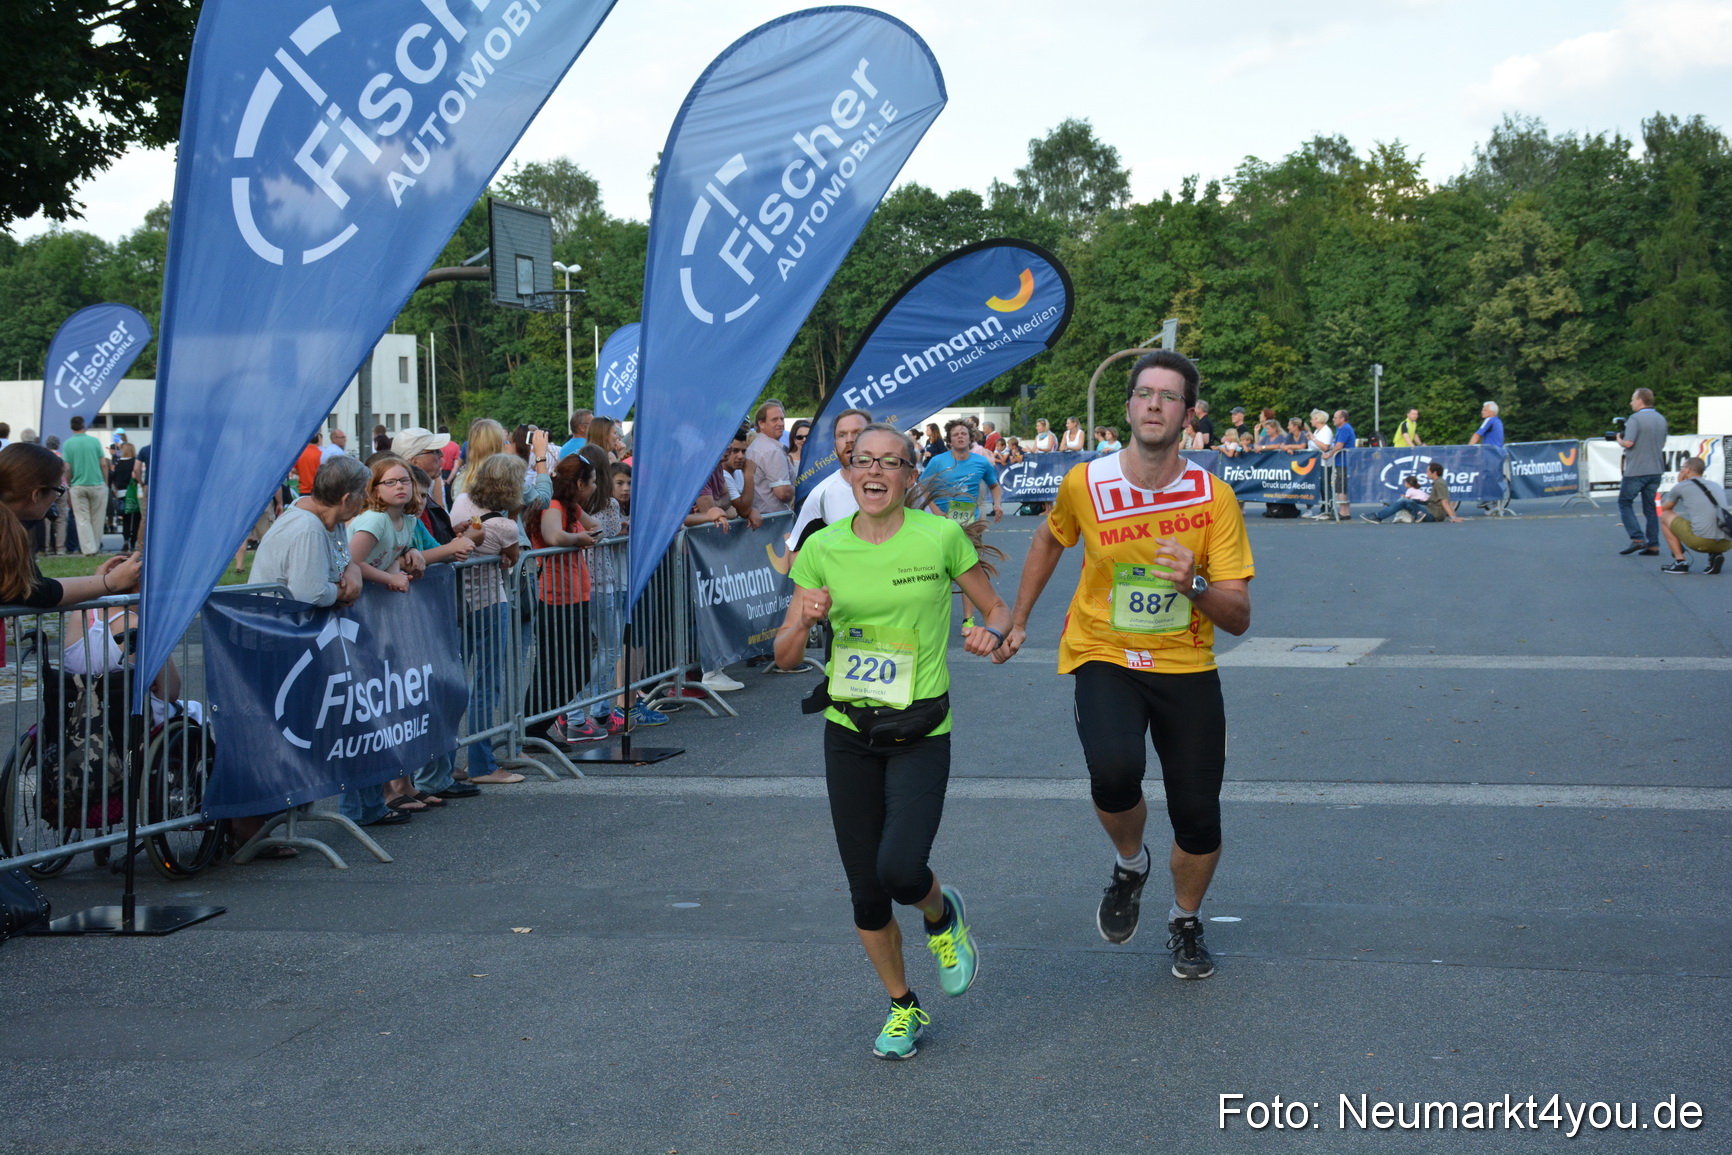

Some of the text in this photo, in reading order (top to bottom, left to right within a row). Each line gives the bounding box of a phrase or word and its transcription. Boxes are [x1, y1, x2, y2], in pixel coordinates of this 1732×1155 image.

[719, 57, 878, 285] Fischer
[777, 100, 898, 282] AUTOMOBILE
[69, 320, 128, 395] Fischer
[948, 305, 1058, 373] Druck und Medien
[90, 334, 135, 394] AUTOMOBILE
[611, 346, 639, 395] Fisch
[625, 369, 638, 394] AUTO
[843, 316, 1003, 410] Frischmann
[1224, 466, 1291, 480] Frischmann
[1262, 481, 1279, 489] Druck
[1292, 482, 1315, 490] Medien
[1511, 459, 1563, 476] Frischmann
[952, 511, 969, 520] 813
[1099, 511, 1213, 546] MAX BÖGL
[696, 565, 775, 608] Frischmann
[892, 573, 940, 587] SMART POWER
[746, 599, 764, 620] Druck
[765, 596, 777, 615] und
[1129, 591, 1178, 614] 887
[845, 655, 897, 684] 220
[315, 660, 433, 729] Fischer
[326, 713, 430, 761] AUTOMOBILE
